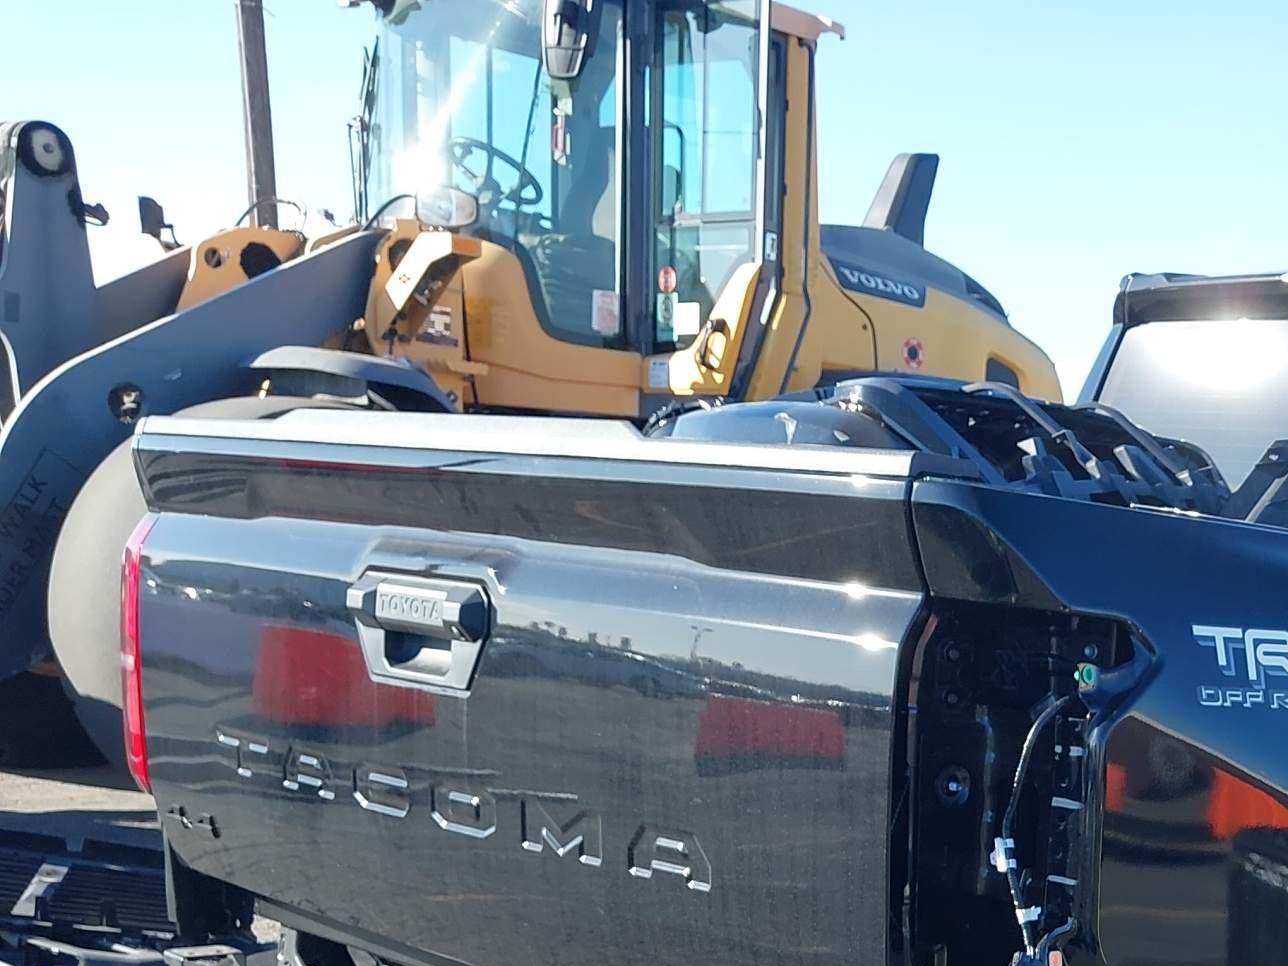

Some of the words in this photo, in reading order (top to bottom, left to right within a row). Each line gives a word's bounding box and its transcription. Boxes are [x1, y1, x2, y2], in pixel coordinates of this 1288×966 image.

[840, 266, 919, 299] VOLVO
[379, 593, 442, 620] TOYOTA
[1198, 685, 1264, 707] OFF
[216, 724, 711, 892] TACOMA
